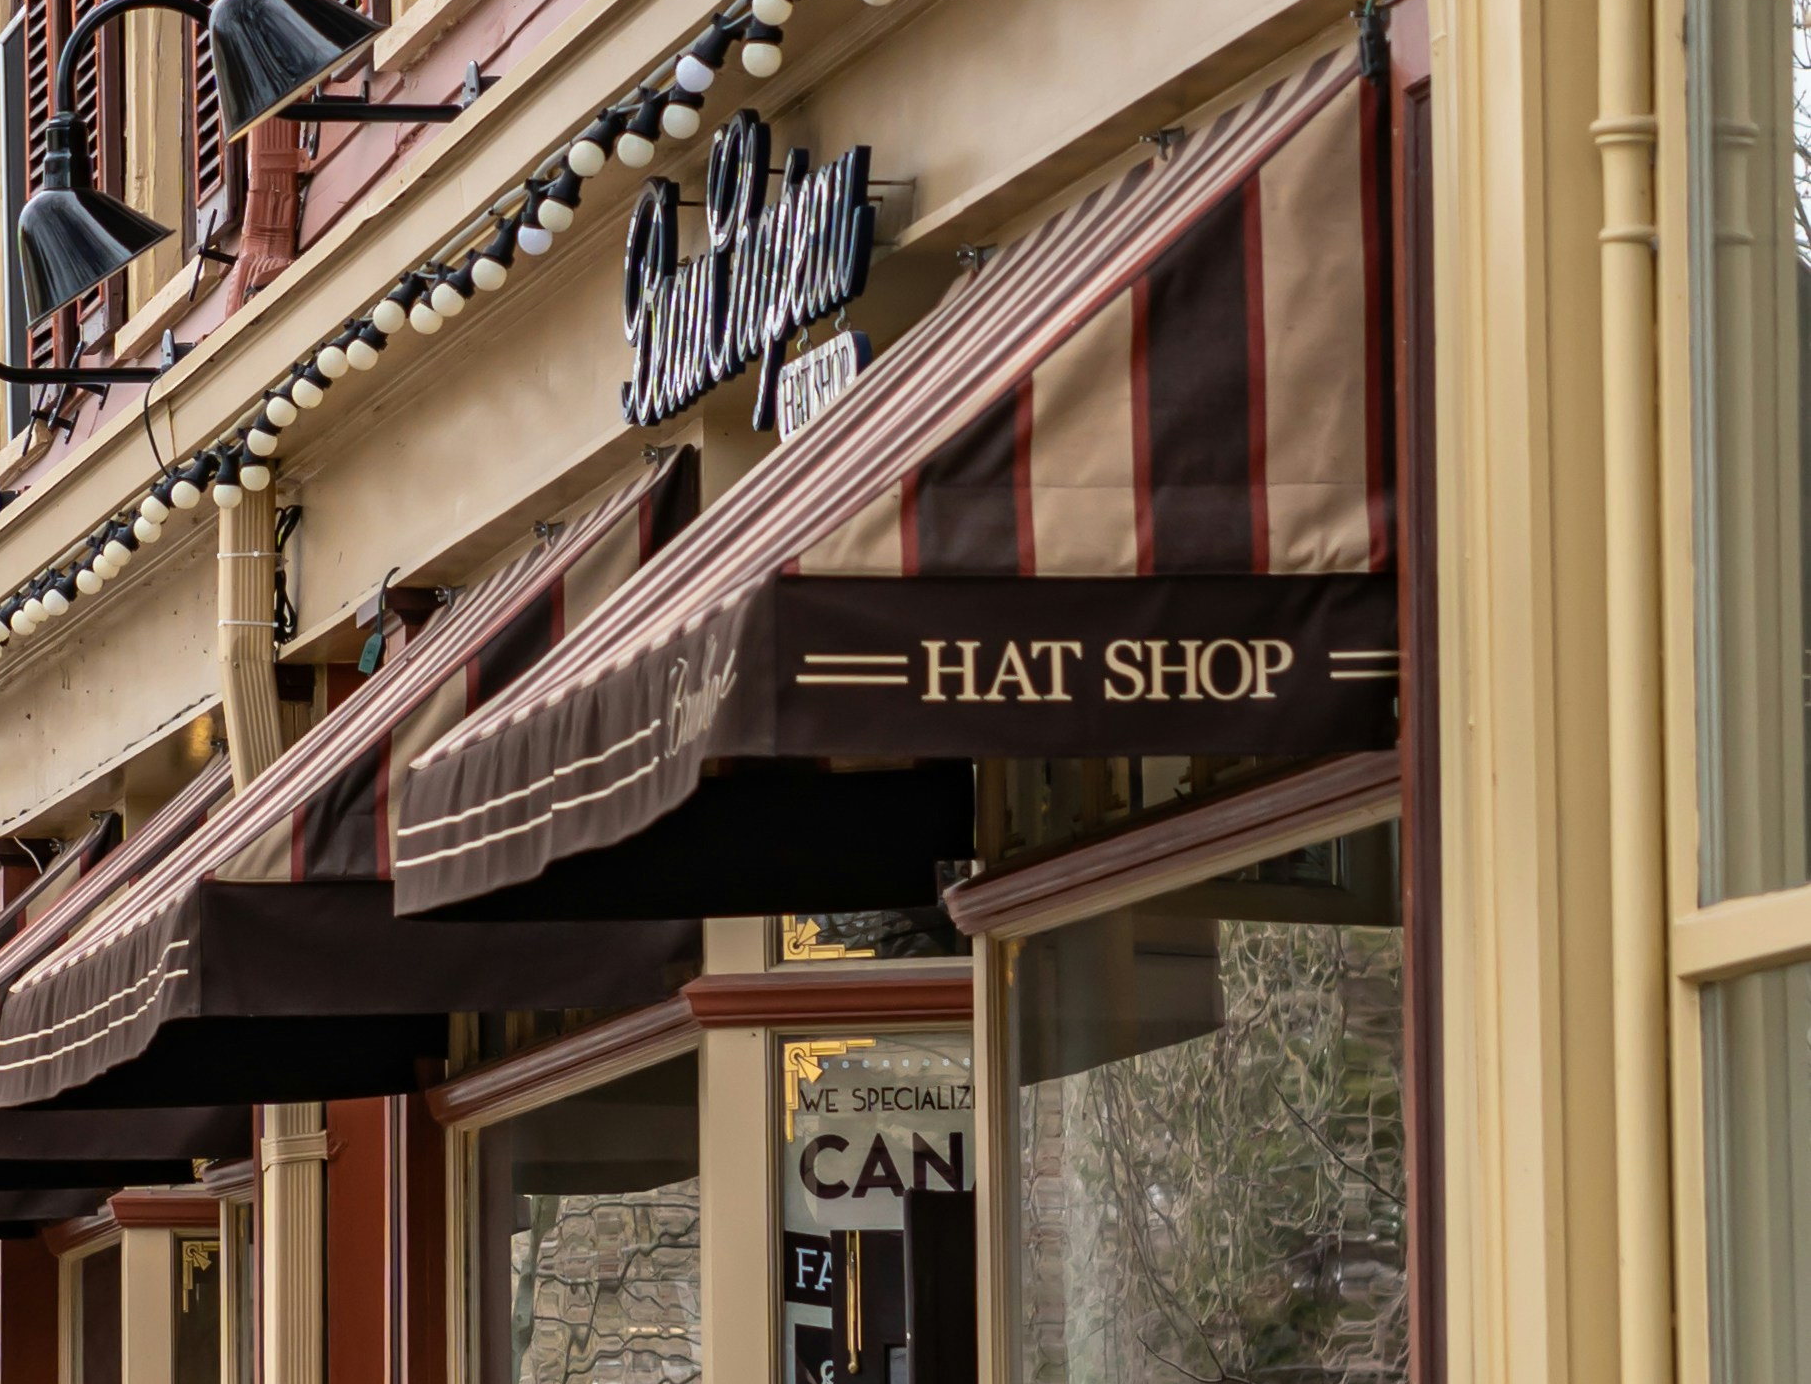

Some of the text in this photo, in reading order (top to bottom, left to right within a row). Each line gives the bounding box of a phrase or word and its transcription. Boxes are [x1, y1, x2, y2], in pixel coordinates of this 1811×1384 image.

[921, 639, 1294, 701] HAT SHOP
[800, 1088, 839, 1114] WE
[799, 1132, 976, 1199] CAN
[795, 1247, 833, 1291] FA
